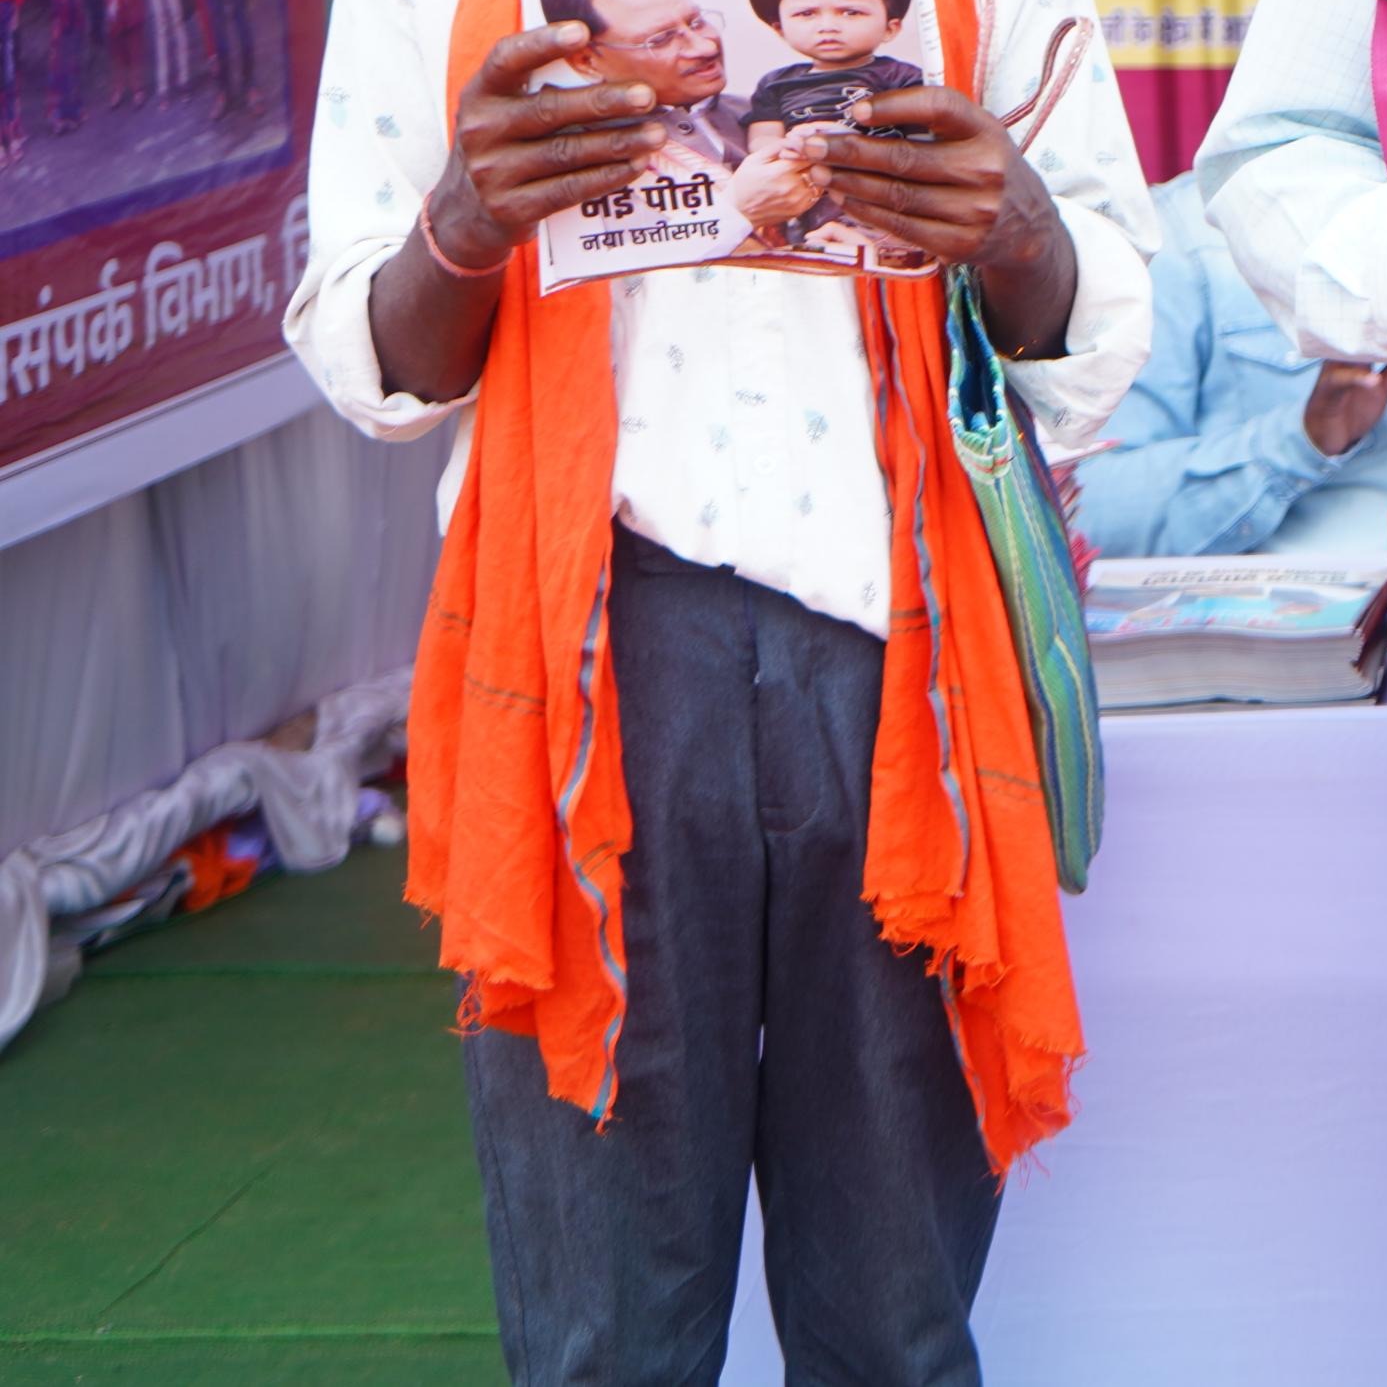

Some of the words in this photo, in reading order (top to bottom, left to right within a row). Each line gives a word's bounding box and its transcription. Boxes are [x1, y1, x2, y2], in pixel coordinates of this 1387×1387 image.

[640, 173, 714, 216] पीढ़ी
[579, 229, 625, 251] नया
[629, 219, 721, 245] छत्तीसगढ़
[0, 257, 136, 404] संपर्क
